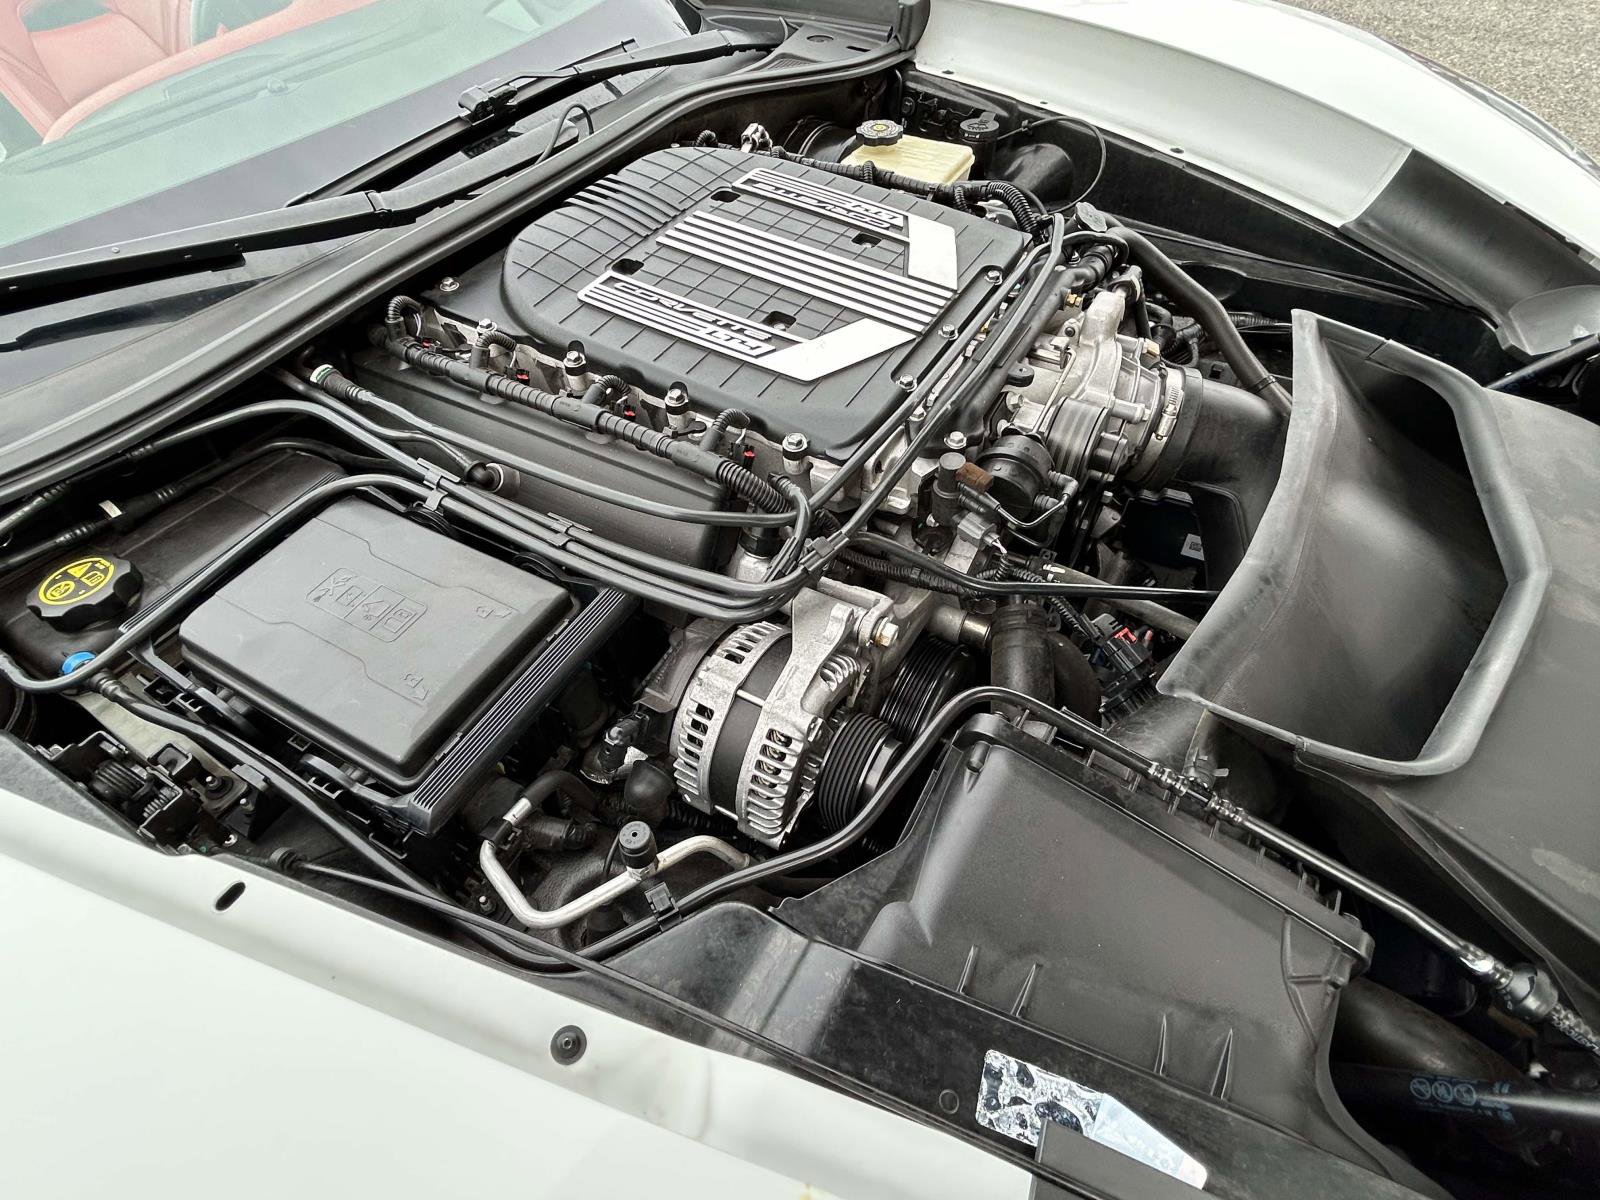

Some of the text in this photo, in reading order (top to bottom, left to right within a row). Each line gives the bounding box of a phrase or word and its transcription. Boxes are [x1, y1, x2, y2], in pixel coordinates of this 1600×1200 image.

[752, 182, 891, 228] CORVETTE
[614, 282, 772, 340] CORVETTE
[706, 330, 762, 350] LT4
